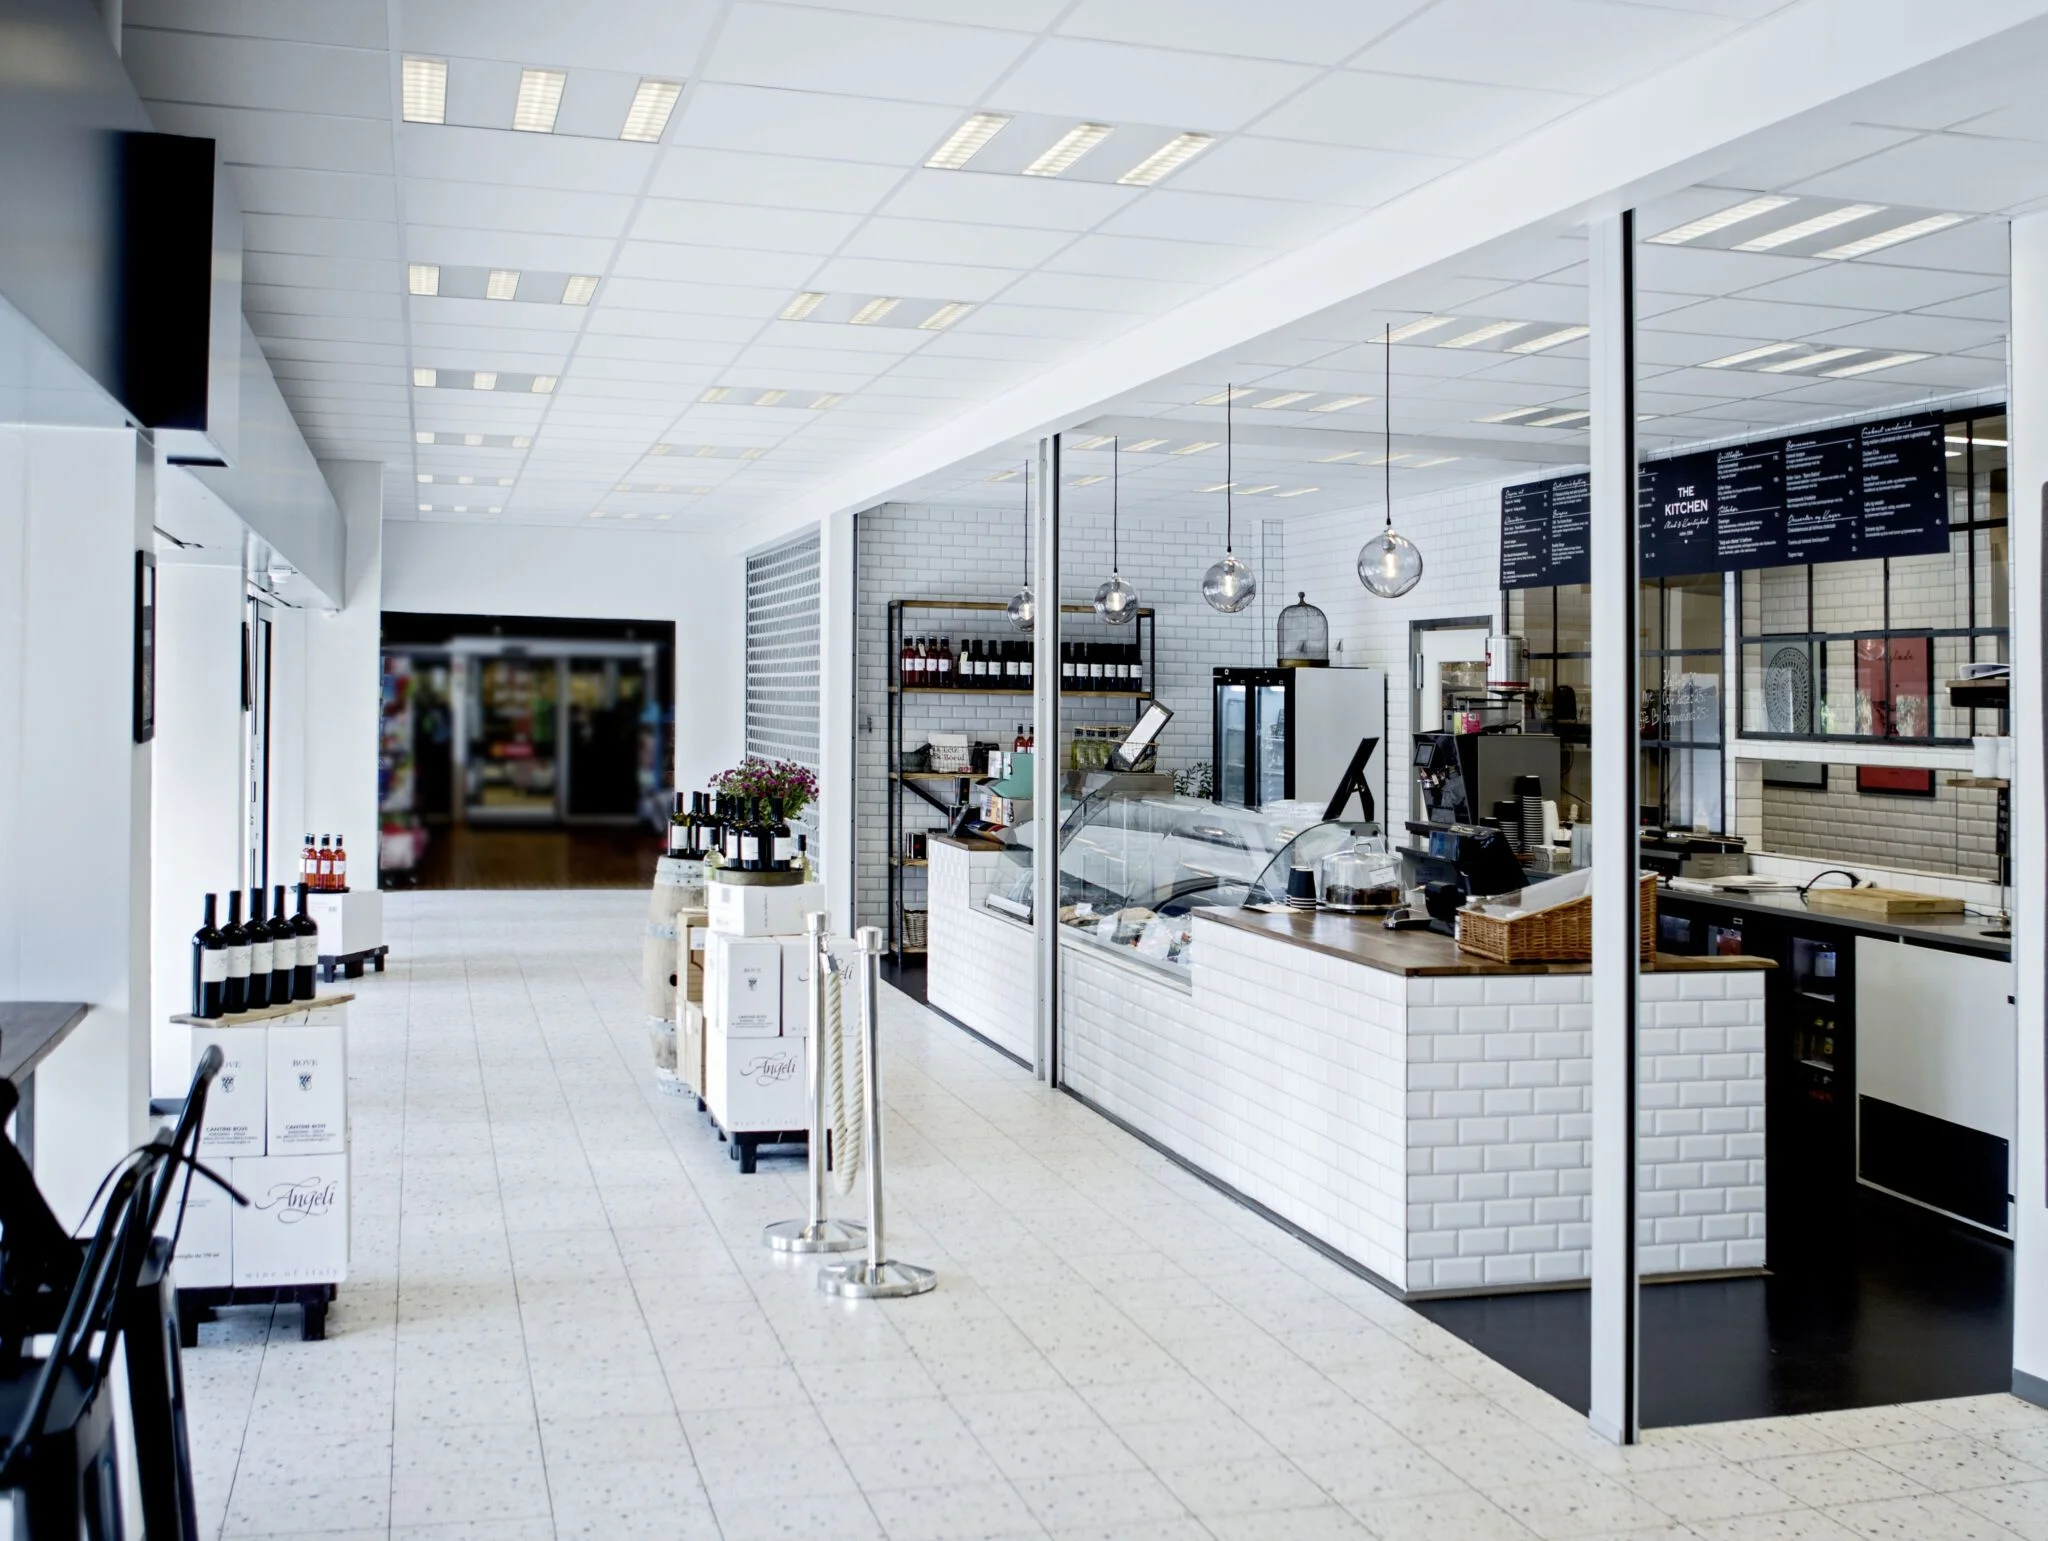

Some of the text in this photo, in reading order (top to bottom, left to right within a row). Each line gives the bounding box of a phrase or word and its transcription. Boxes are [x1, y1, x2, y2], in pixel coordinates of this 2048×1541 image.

[1677, 485, 1695, 498] THE
[1664, 498, 1709, 517] KITCHEN
[292, 1058, 318, 1067] BOVE
[740, 1051, 798, 1087] Angeli
[255, 1176, 338, 1224] Angeli
